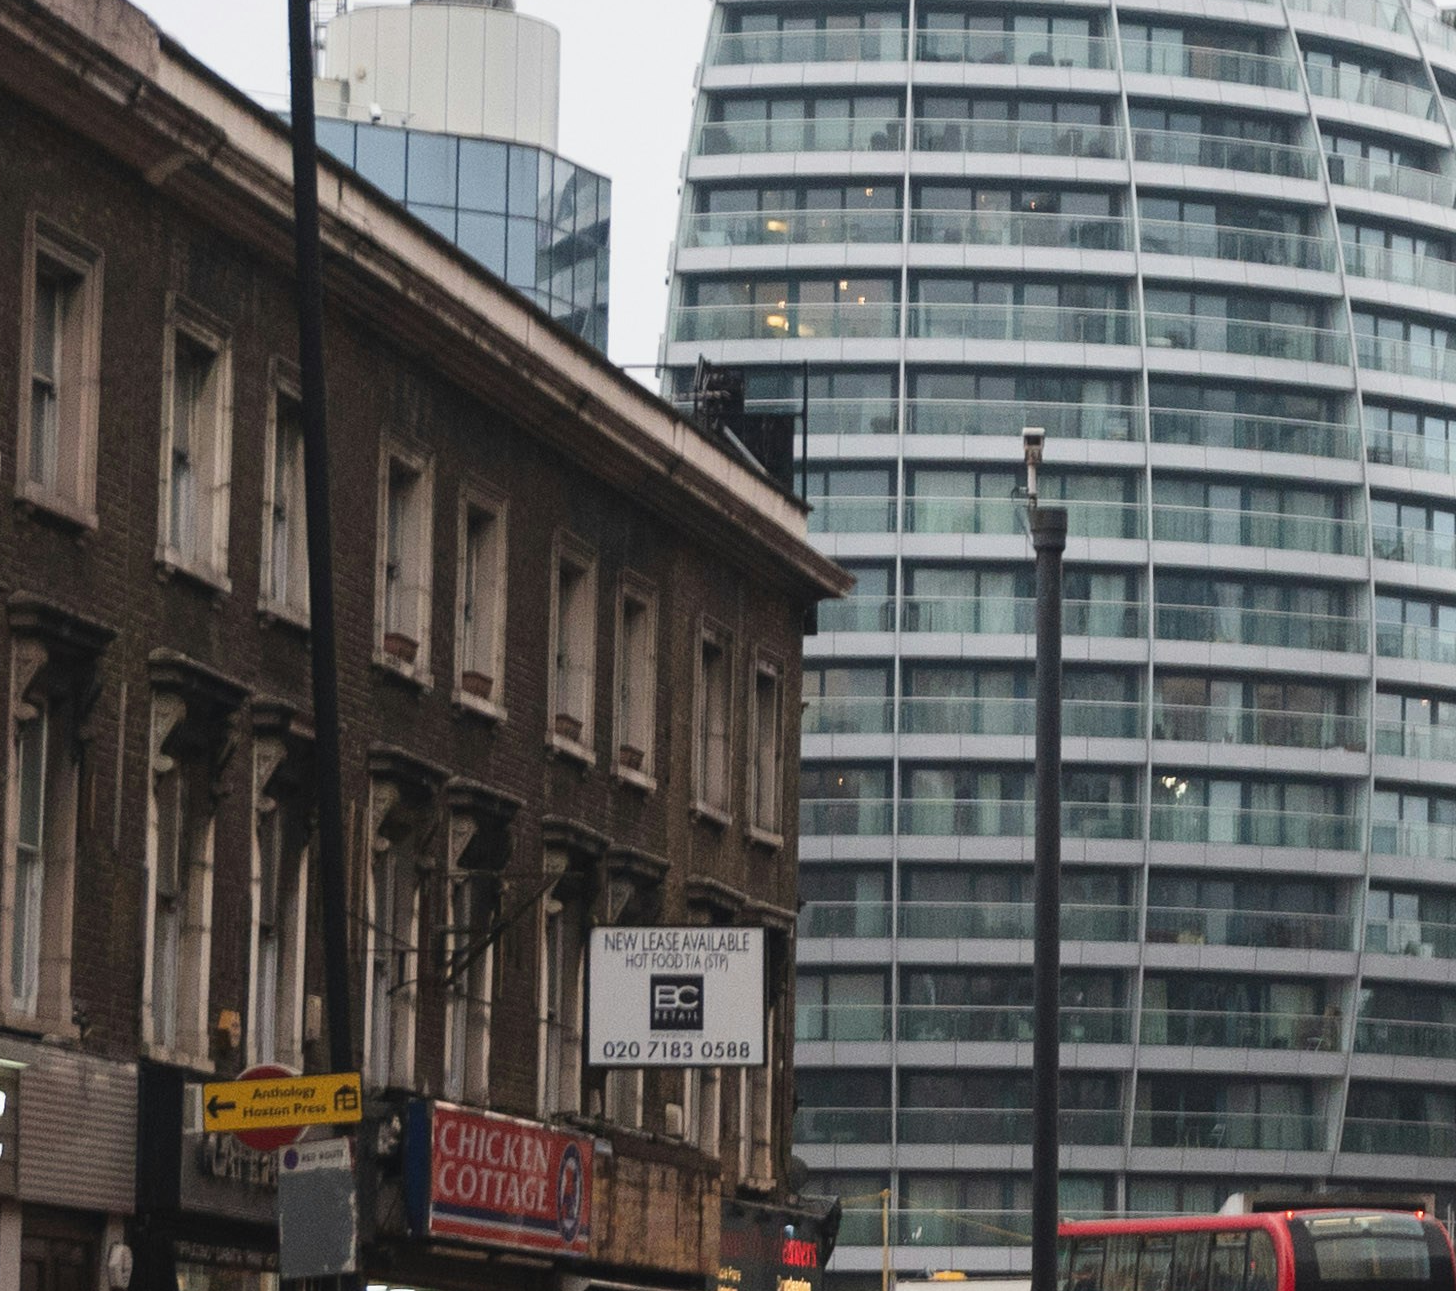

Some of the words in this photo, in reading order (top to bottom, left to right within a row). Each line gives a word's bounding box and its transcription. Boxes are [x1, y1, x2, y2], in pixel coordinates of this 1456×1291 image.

[604, 932, 638, 952] NEW
[642, 932, 680, 952] LEASE
[682, 932, 750, 952] AVAILABLE
[625, 953, 648, 968] HOT
[651, 953, 684, 968] FOOD
[654, 1011, 699, 1021] RETAIL
[603, 1041, 640, 1058] 020
[647, 1041, 693, 1058] 7183
[701, 1041, 750, 1058] 0588
[252, 1085, 317, 1101] Anthology
[293, 1102, 327, 1117] Press
[439, 1120, 551, 1173] CHICKEN
[439, 1160, 550, 1212] COTTAGE
